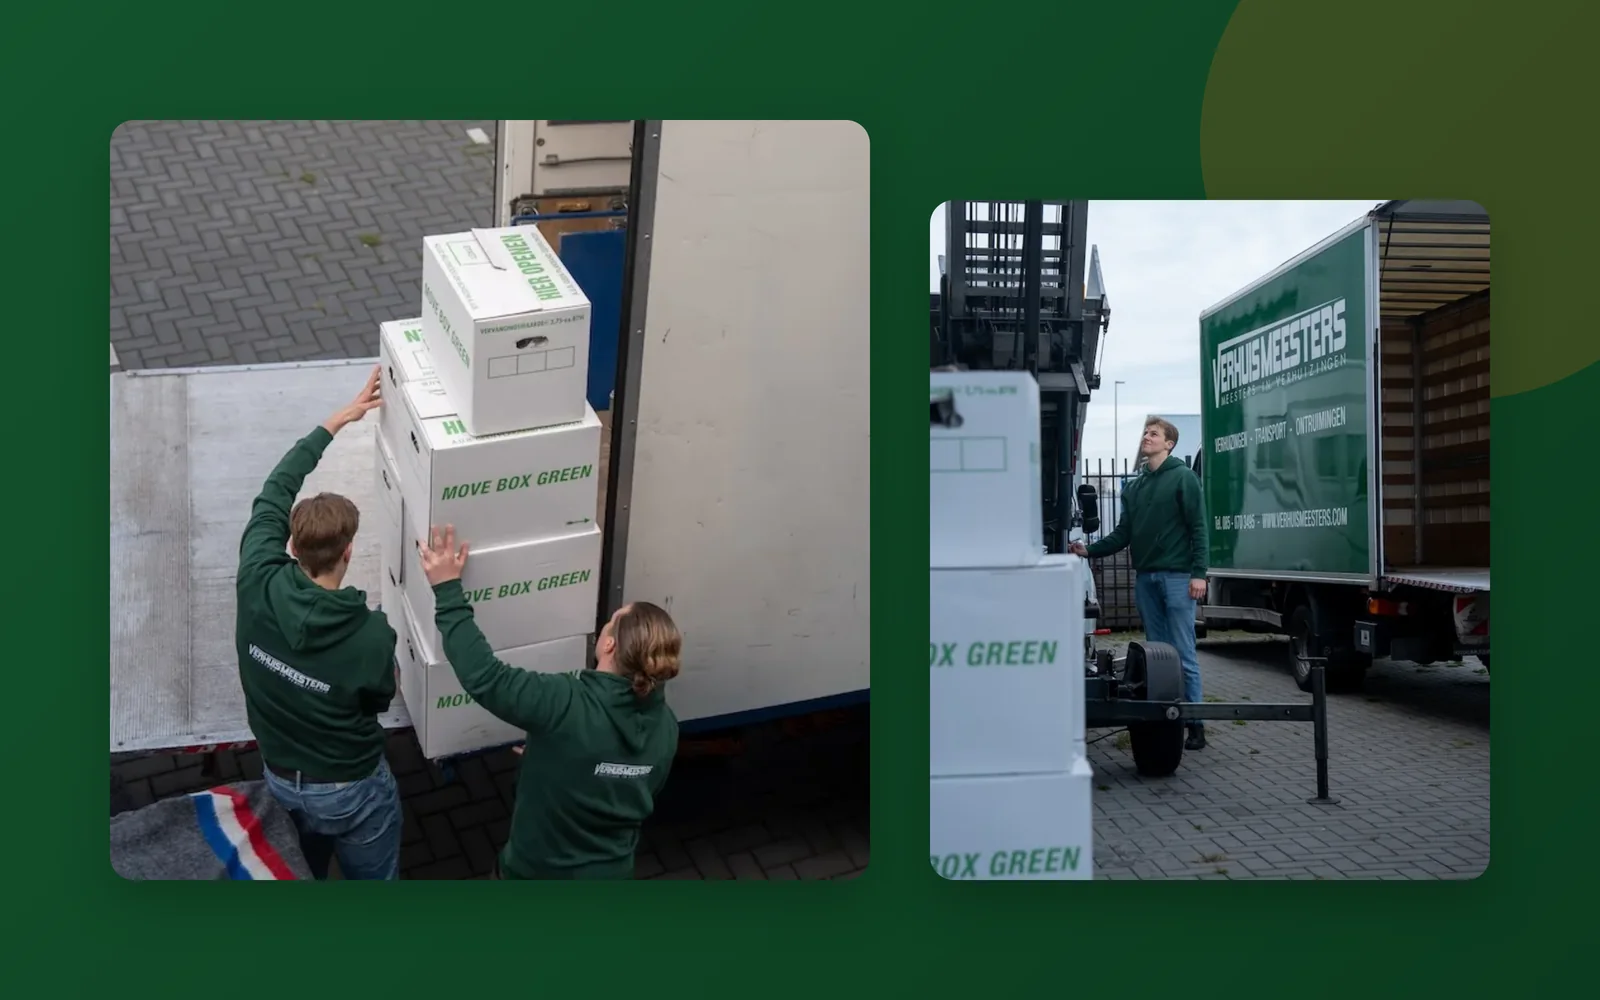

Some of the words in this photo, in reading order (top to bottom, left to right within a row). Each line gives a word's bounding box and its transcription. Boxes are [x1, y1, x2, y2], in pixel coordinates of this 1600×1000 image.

[500, 234, 545, 275] OPENEN
[528, 275, 563, 300] HIER
[1212, 296, 1346, 409] VERHUISMEESTERS
[1220, 385, 1257, 406] MEESTERS
[1261, 379, 1271, 391] IN
[1275, 353, 1347, 386] VERHUIZINGEN
[442, 420, 467, 435] HI
[1214, 431, 1248, 453] VERHUIZINGEN
[1254, 421, 1288, 445] TRANSPORT
[1295, 406, 1346, 436] ONTRUIMINGEN
[441, 480, 492, 501] MOVE
[496, 474, 531, 492] BOX
[537, 464, 592, 485] GREEN
[1262, 507, 1348, 529] WWW.VERHUISMEESTERS.COM
[462, 586, 492, 603] OVE
[497, 579, 532, 599] BOX
[537, 569, 591, 591] GREEN
[248, 643, 331, 692] VERHUISMEESTERS
[966, 640, 1058, 667] GREEN
[437, 693, 472, 709] MOV
[988, 846, 1082, 877] GREEN
